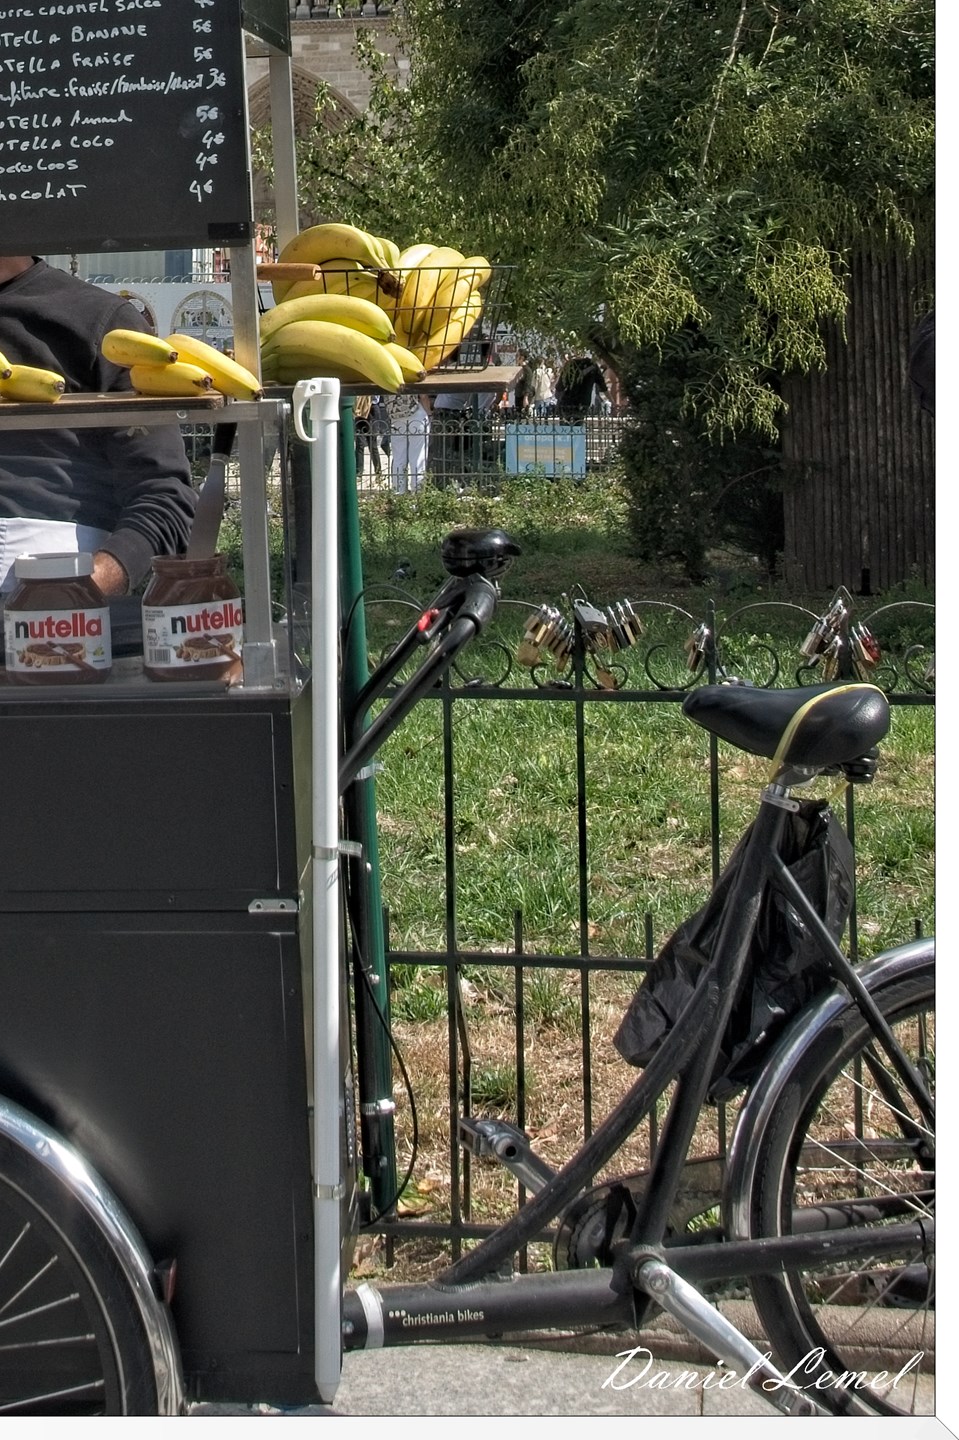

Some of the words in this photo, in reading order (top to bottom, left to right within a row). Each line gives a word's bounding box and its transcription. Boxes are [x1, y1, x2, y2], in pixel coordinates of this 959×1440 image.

[71, 24, 148, 43] BANANE
[14, 612, 103, 639] nutella
[402, 1311, 454, 1327] christiania
[457, 1309, 485, 1322] bikes
